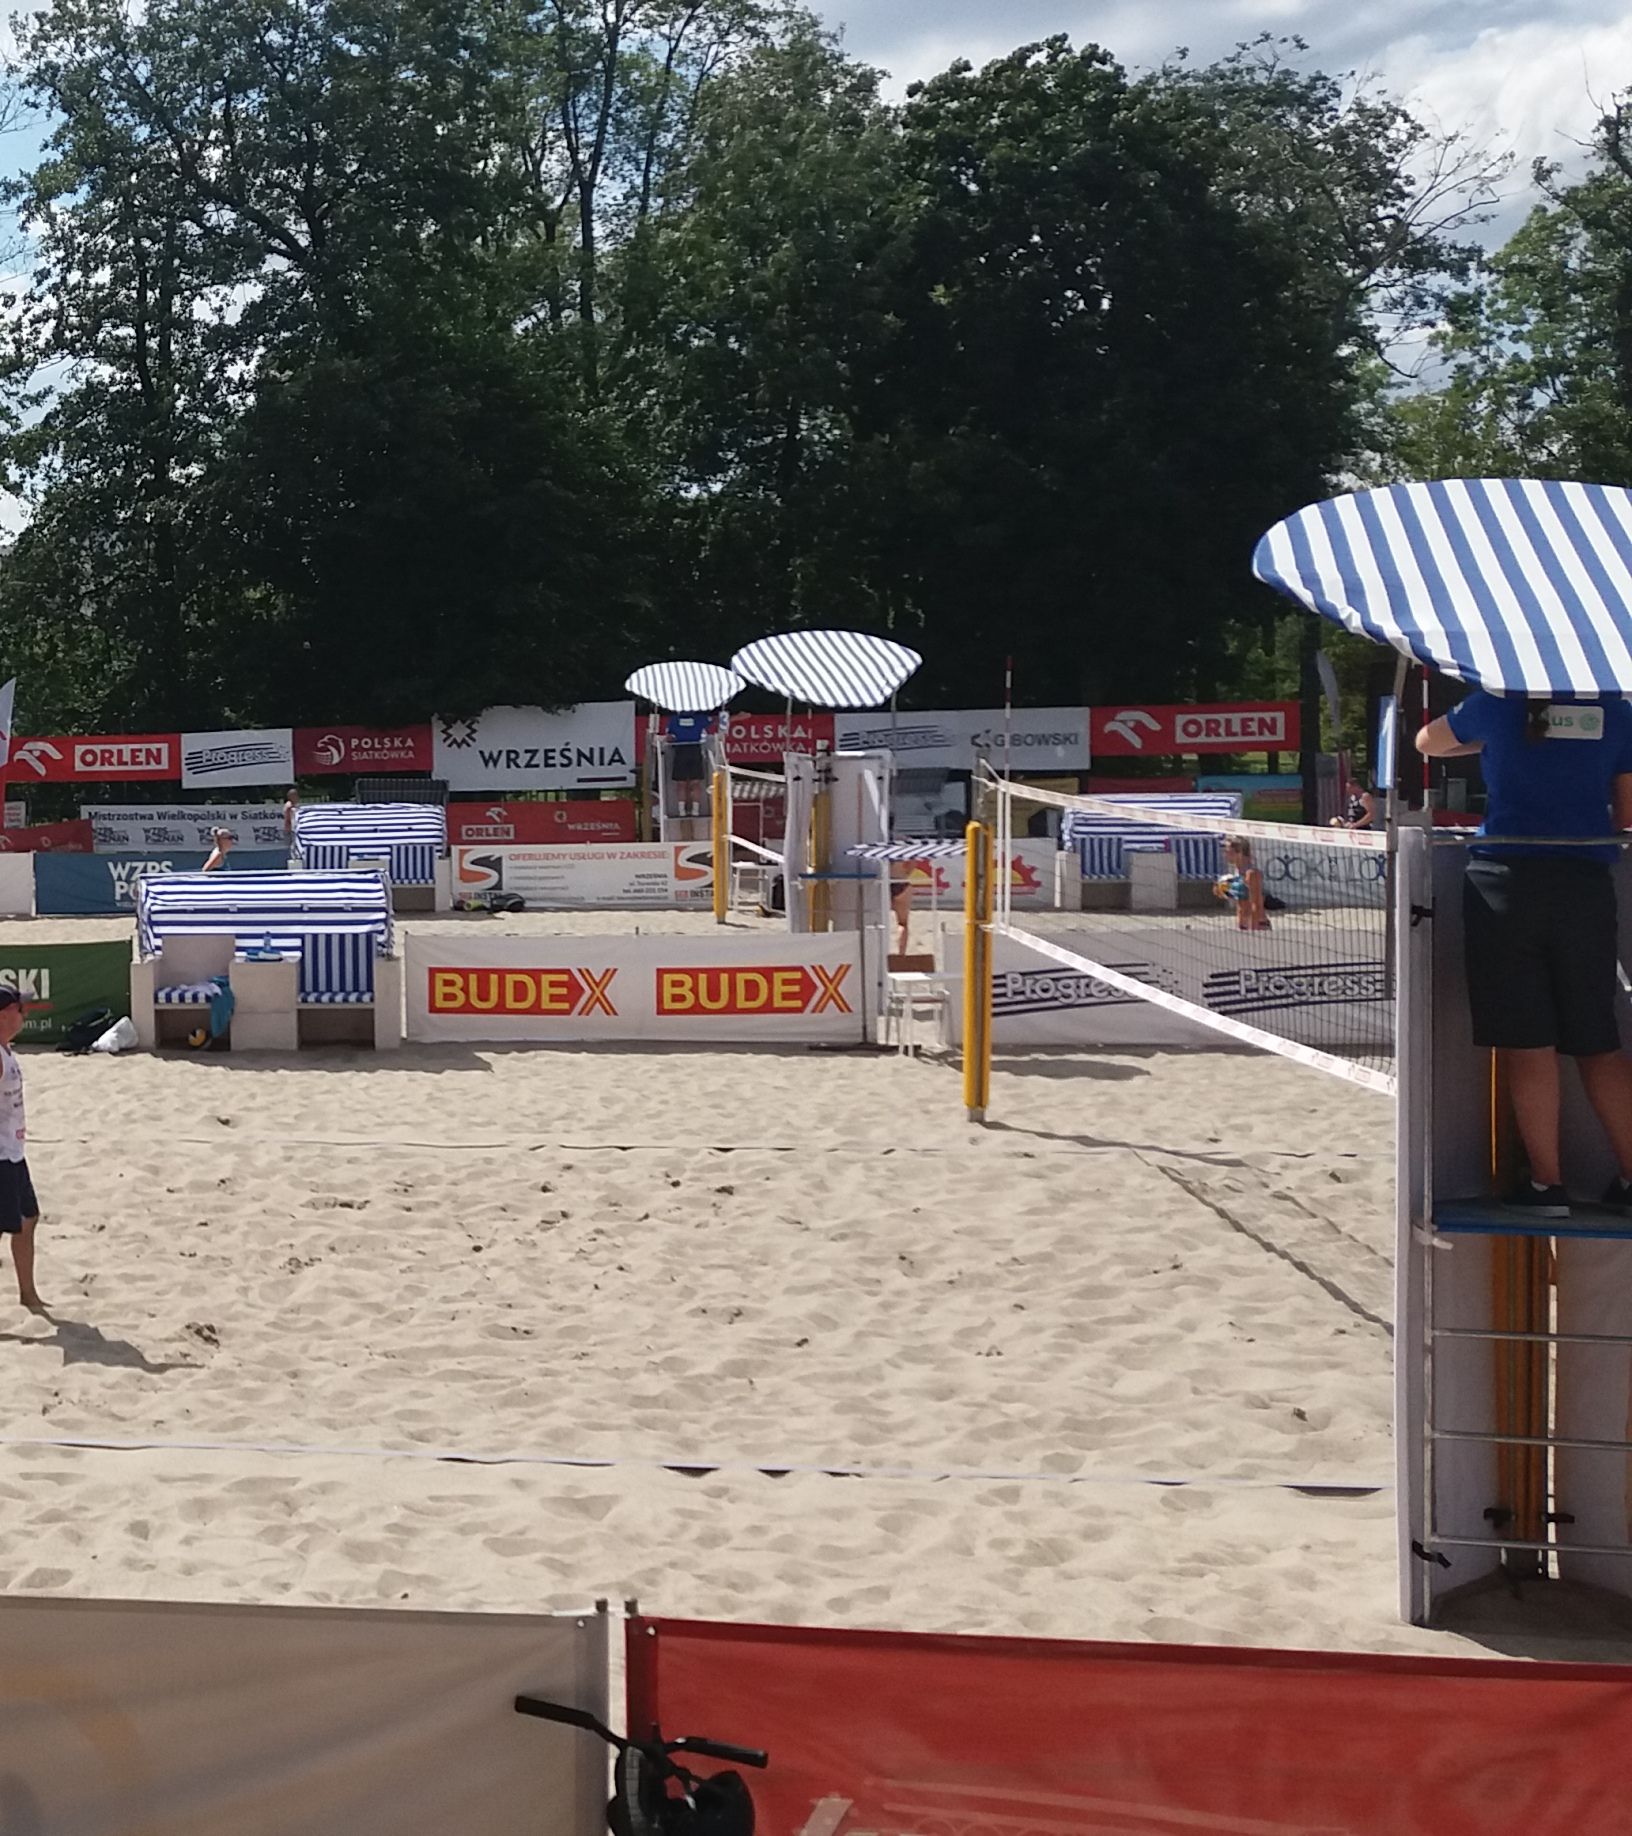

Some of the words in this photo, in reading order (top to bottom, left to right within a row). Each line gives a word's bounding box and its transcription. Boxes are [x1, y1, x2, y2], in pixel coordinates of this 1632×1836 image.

[732, 725, 808, 739] OLSKA
[1182, 717, 1277, 738] ORLEN
[350, 736, 415, 749] POLSKA
[994, 732, 1079, 747] GBOWSKI
[726, 740, 806, 754] IATKÓWKA
[79, 748, 162, 767] ORLEN
[201, 749, 270, 765] Progress
[350, 749, 415, 762] SIATKÓWKA
[479, 742, 627, 770] WRZEŚNIA
[88, 810, 154, 821] Mistrzostwa
[157, 810, 226, 823] Wielkopolski
[241, 810, 285, 821] Siatków
[464, 827, 511, 838] ORLEN
[509, 852, 568, 861] OFERUJEMY
[607, 851, 618, 860] W
[619, 850, 667, 860] ZAKRESIE
[434, 965, 619, 1016] BUDEX
[662, 963, 853, 1013] BUDEX
[1005, 972, 1130, 1003] Progres
